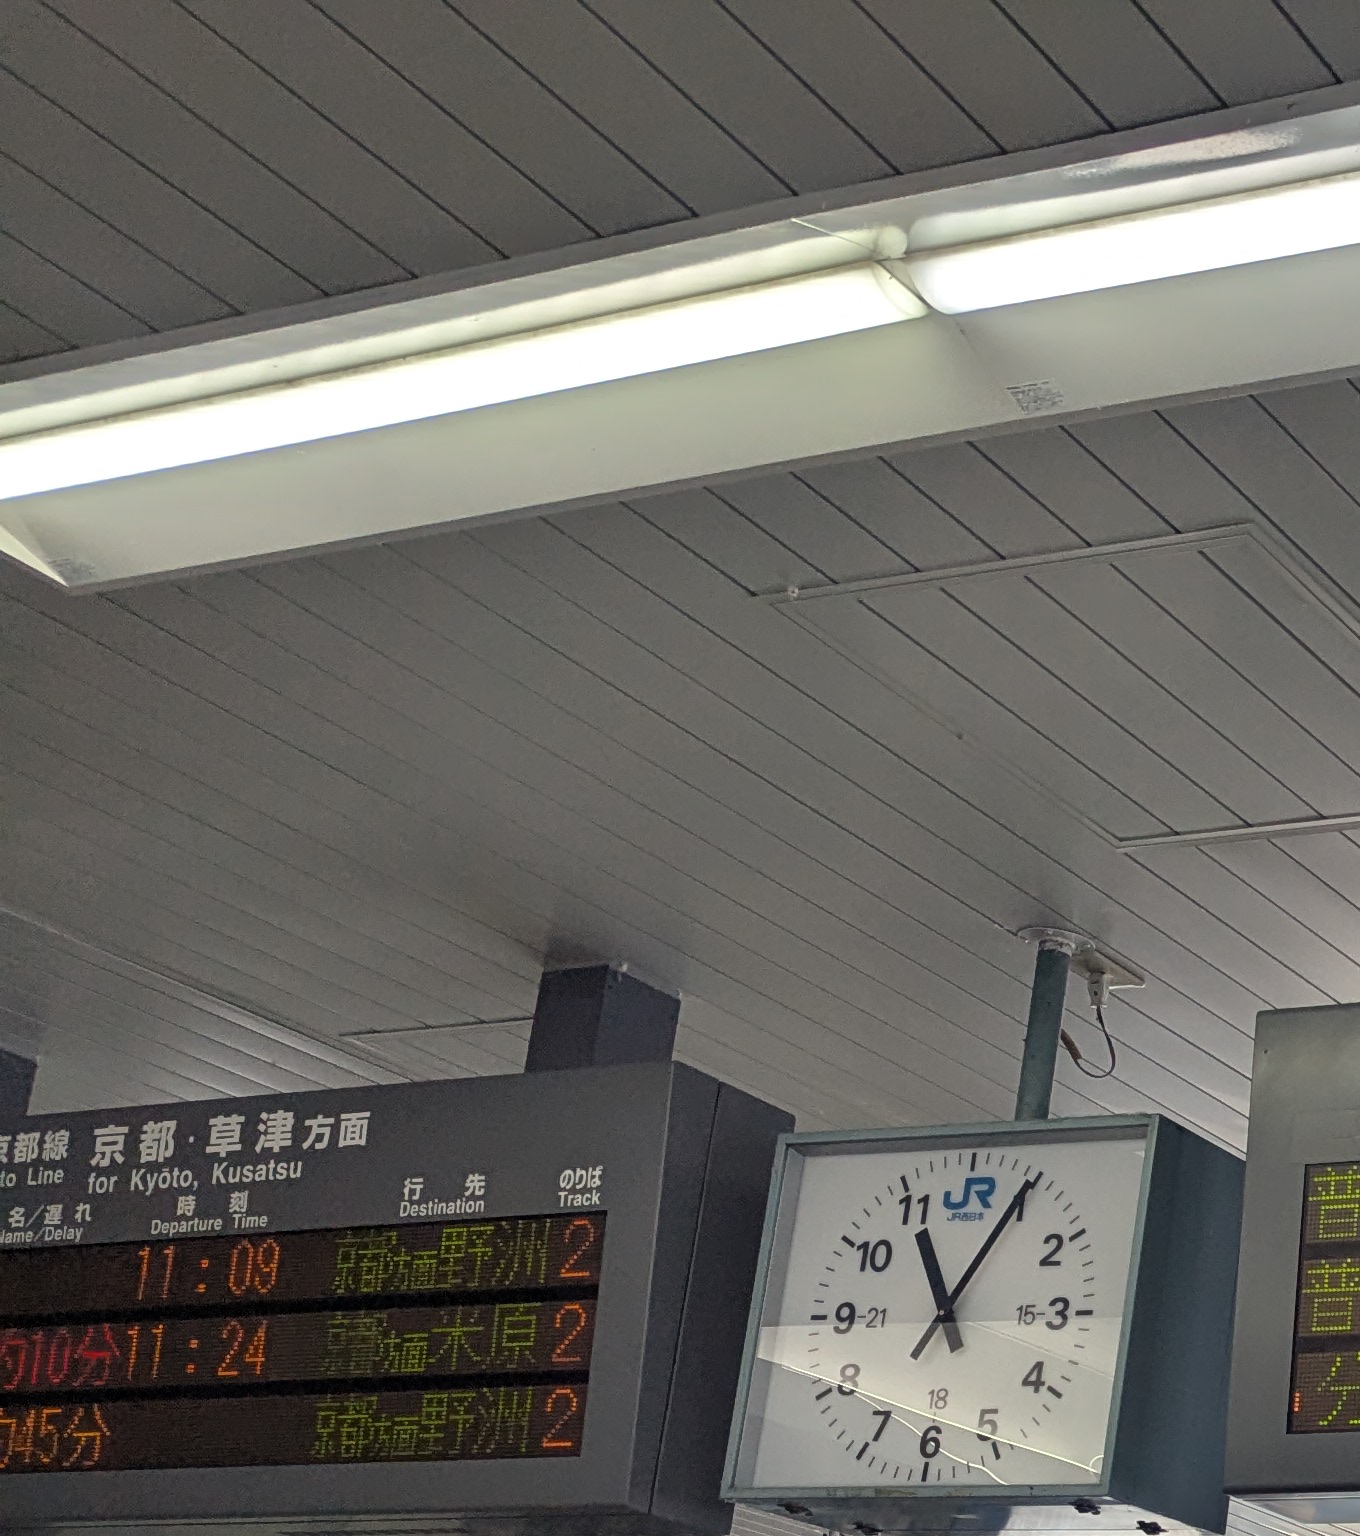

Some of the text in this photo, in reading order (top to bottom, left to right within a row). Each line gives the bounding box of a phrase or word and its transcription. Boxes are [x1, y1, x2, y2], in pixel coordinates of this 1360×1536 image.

[0, 1130, 70, 1164] 都線
[27, 1168, 64, 1185] Line
[87, 1173, 117, 1194] for
[130, 1167, 198, 1195] Kyōto,
[212, 1159, 303, 1185] Kusatsu
[560, 1166, 603, 1190] のりば
[943, 1177, 997, 1210] JR
[400, 1199, 485, 1217] Destination
[558, 1191, 600, 1207] Track
[899, 1194, 930, 1225] 11
[151, 1213, 268, 1237] Departure Time
[947, 1211, 984, 1222] JR西日本
[560, 1219, 594, 1277] 2
[857, 1239, 892, 1272] 10
[1039, 1233, 1064, 1267] 2
[552, 1303, 586, 1362] 2
[838, 1363, 860, 1397] 8
[1022, 1361, 1046, 1393] 4
[927, 1388, 949, 1410] 18
[542, 1387, 577, 1448] 2
[872, 1410, 892, 1442] 7
[977, 1408, 999, 1441] 5
[919, 1425, 942, 1459] 6
